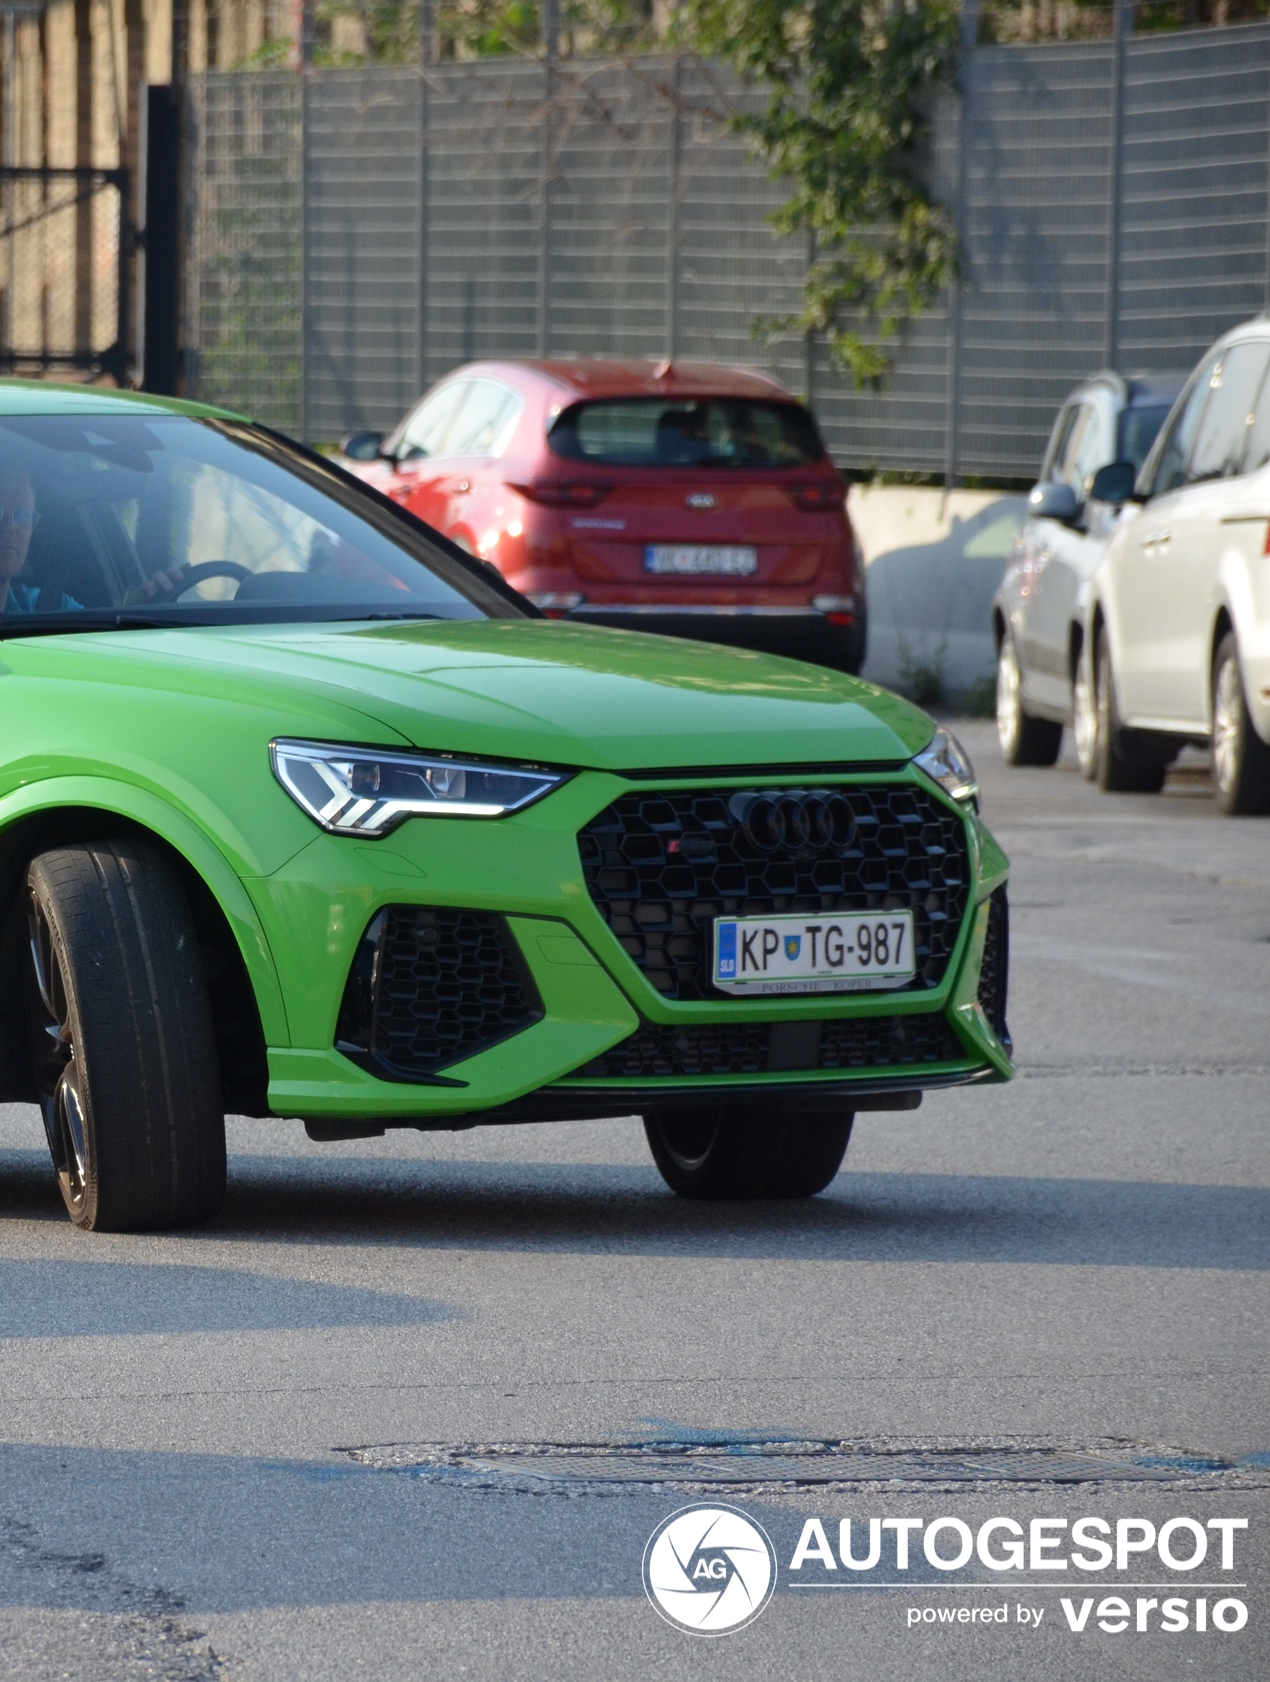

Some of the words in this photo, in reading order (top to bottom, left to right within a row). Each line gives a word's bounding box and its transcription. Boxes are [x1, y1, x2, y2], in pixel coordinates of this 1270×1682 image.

[741, 928, 779, 972] KP
[805, 922, 905, 968] TG-987
[720, 959, 735, 973] SLO
[762, 981, 820, 993] PORSCHE
[833, 979, 872, 991] KOPER
